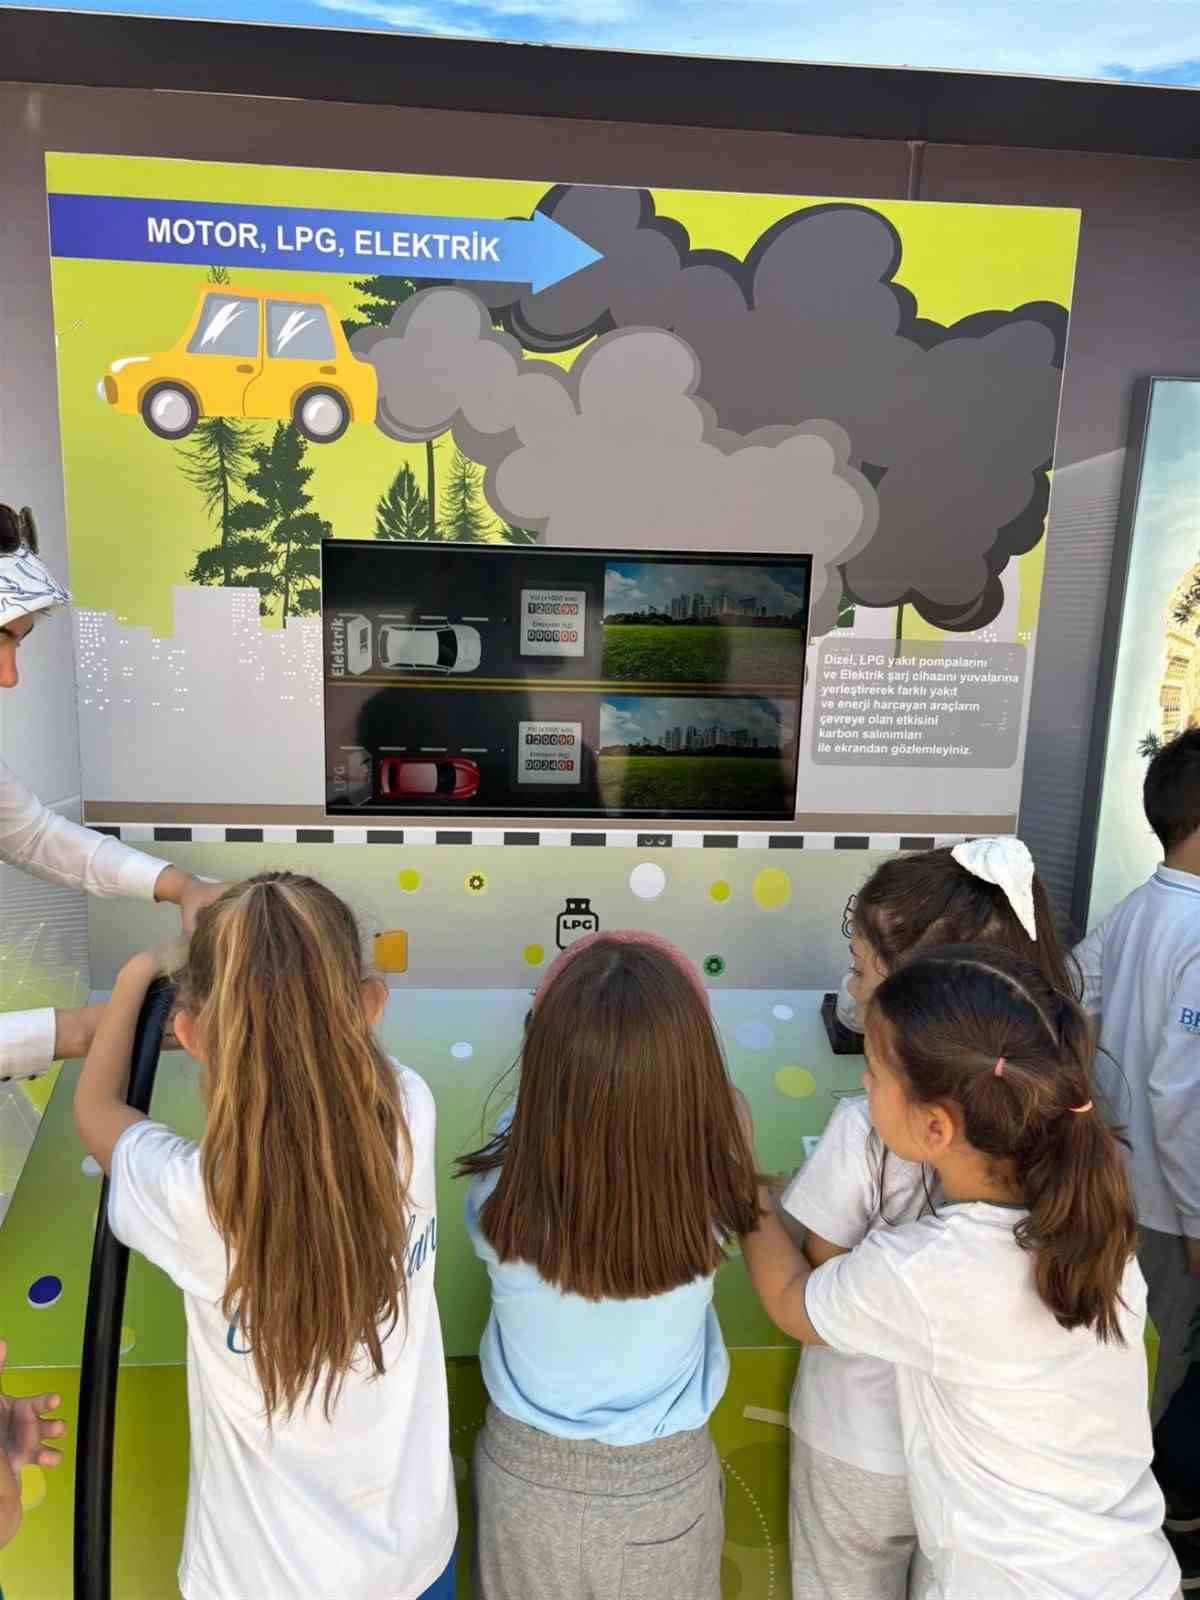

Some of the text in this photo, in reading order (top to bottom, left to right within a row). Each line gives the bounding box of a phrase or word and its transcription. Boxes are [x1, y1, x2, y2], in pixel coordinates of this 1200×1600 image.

[147, 217, 501, 262] MOTOR, LPG, ELEKTRİK
[528, 630, 577, 642] 000000
[331, 618, 344, 676] Elektrik
[824, 653, 988, 669] Dizel, LPG yakıt pompalarını
[824, 669, 1018, 684] ve Elektrik şarj cihazını yuvalarına
[822, 684, 958, 698] yerleştirerek farklı yakıt
[821, 701, 834, 710] ve
[838, 699, 871, 712] enerji
[929, 700, 980, 712] araçların
[820, 713, 938, 727] çevreye olan etkisini
[819, 727, 922, 740] karbon salınımları
[817, 742, 831, 753] ile
[834, 743, 888, 754] ekrandan
[563, 920, 592, 929] LPG
